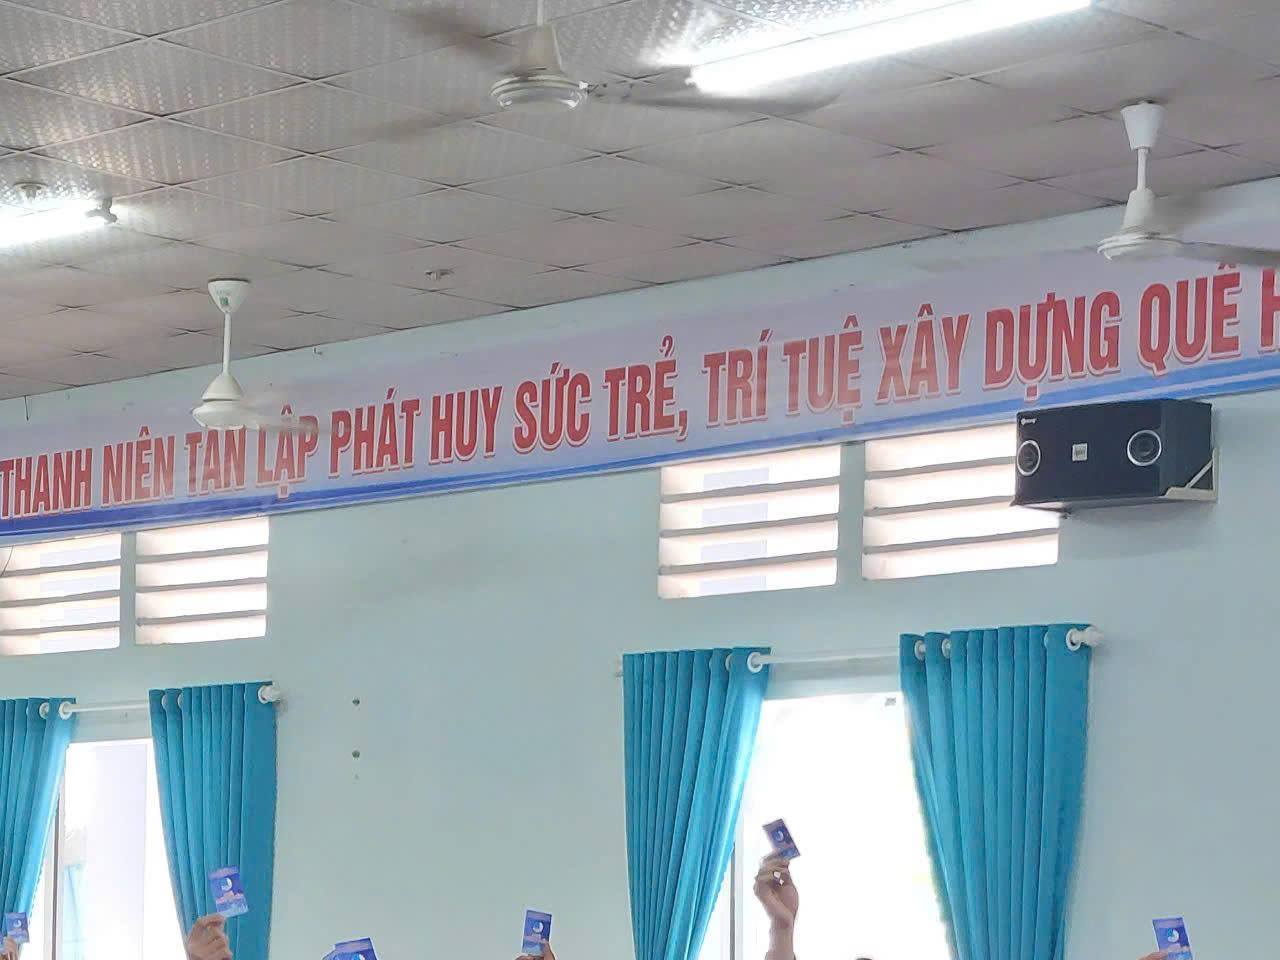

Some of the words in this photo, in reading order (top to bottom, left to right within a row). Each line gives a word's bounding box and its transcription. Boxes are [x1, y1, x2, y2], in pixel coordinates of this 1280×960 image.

[0, 448, 93, 519] THANH
[101, 426, 176, 505] NIÊN
[257, 403, 319, 497] LẬP
[329, 387, 421, 475] PHÁT
[429, 386, 504, 463] HUY
[514, 361, 591, 452] SỨC
[603, 335, 688, 439] TRẺ,
[702, 328, 774, 428] TRÍ
[783, 314, 863, 422] TUỆ
[876, 302, 970, 401] XÂY
[983, 290, 1122, 399] DỰNG
[1137, 263, 1241, 375] QUÊ
